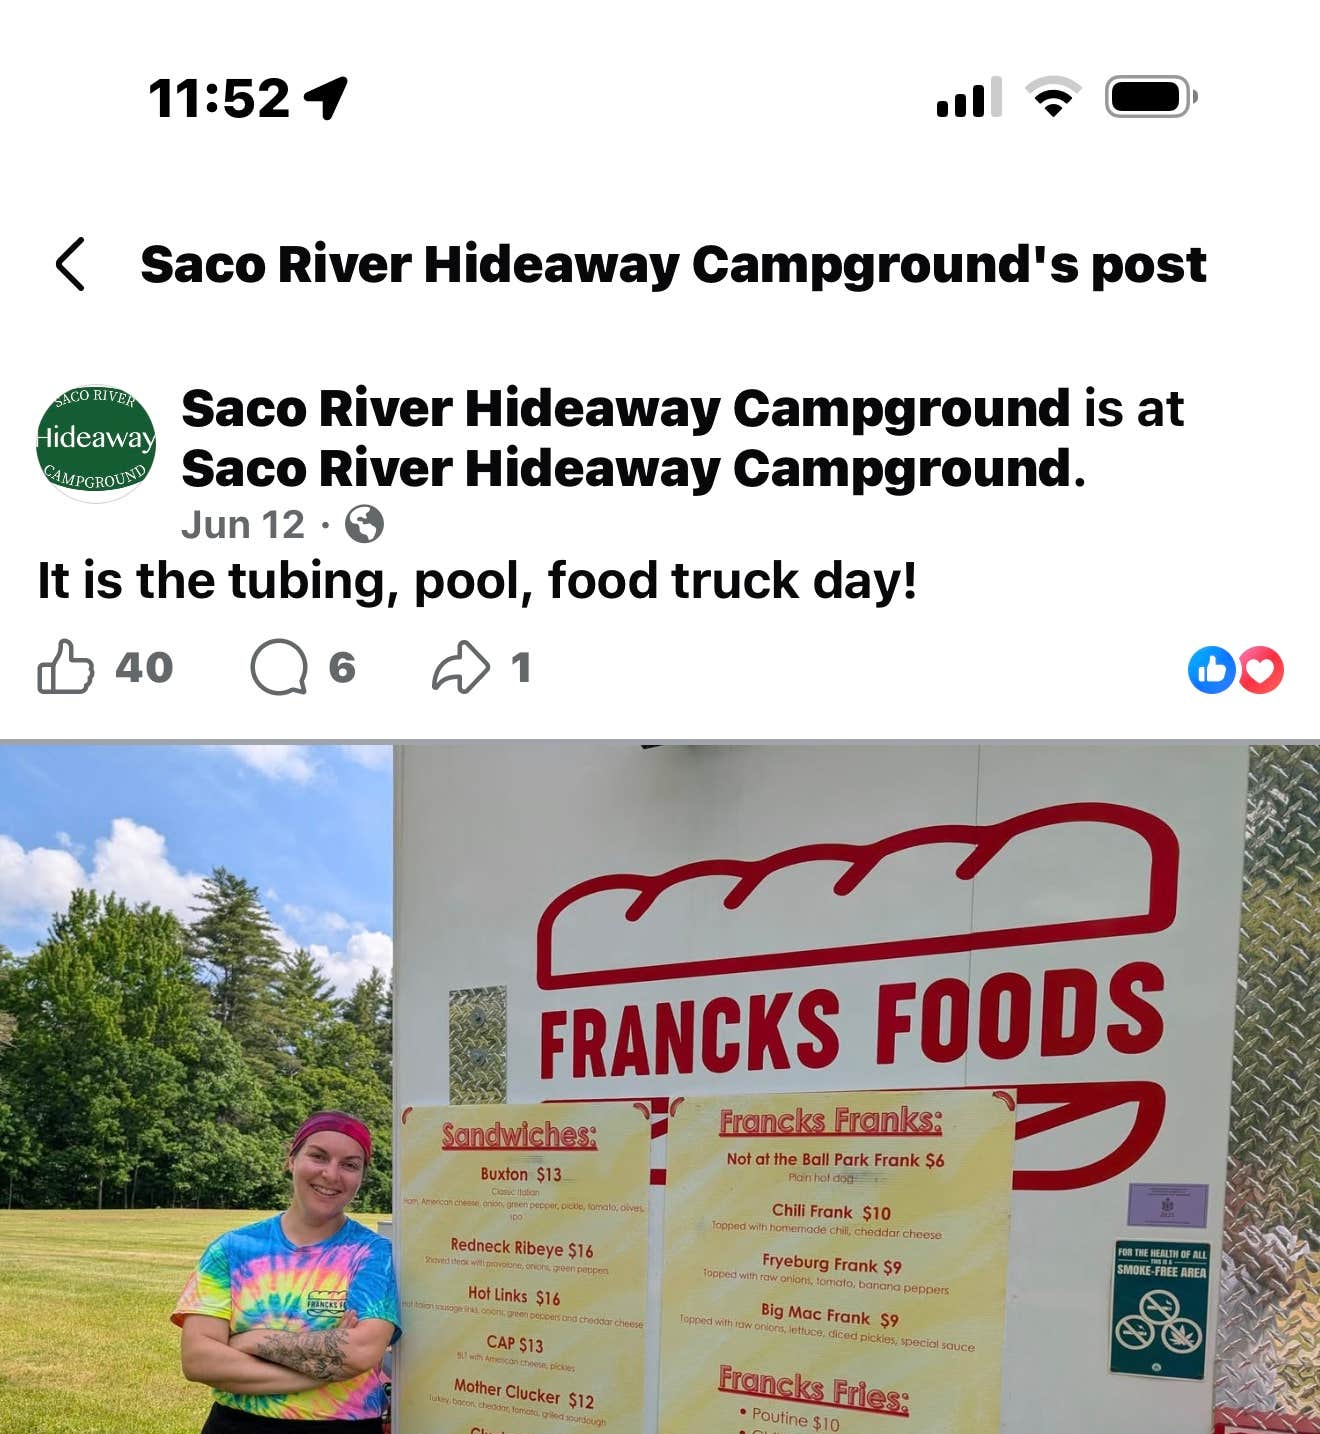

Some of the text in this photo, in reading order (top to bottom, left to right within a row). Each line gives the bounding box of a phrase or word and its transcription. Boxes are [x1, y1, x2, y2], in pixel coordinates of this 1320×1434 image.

[149, 77, 290, 119] 11:52
[141, 239, 1207, 293] Saco River Hideaway Campground's post
[55, 390, 136, 408] SACO RIVER
[182, 384, 1185, 437] Saco River Hideaway Campground is at
[36, 424, 157, 454] Hideaway
[44, 464, 146, 488] CAMPGROUND
[182, 444, 1085, 497] Saco River Hideaway Campground.
[181, 509, 305, 539] Jun 12
[39, 557, 916, 609] It is the tubing, pool, food truck day!
[115, 651, 173, 684] 40
[329, 651, 356, 684] 6
[512, 652, 529, 683] 1
[540, 961, 1165, 1080] FRANCKS FOODS
[720, 1106, 943, 1134] Francks Franks:
[442, 1121, 597, 1149] Sandwiches:
[481, 1166, 562, 1183] Buxton $13
[727, 1152, 945, 1170] Not at the Ball Park Frank $6
[517, 1188, 540, 1197] Italian
[789, 1172, 855, 1185] Plain hot dog
[772, 1203, 892, 1222] Chili Frank $10
[712, 1220, 943, 1241] Topped with homemade chili, cheddar cheese
[451, 1237, 594, 1260] Redneck Ribeye $16
[1118, 1247, 1208, 1260] FOR THE HEALTH OF ALL
[762, 1253, 903, 1277] Fryeburg Frank $9
[1117, 1264, 1207, 1279] SMOKE-FREE AREA
[703, 1267, 950, 1296] Topped with raw onions, tomato, banana peppers
[308, 1300, 338, 1309] FRANCKS
[468, 1286, 560, 1307] Hot Links $16
[761, 1302, 900, 1330] Big Mac Frank $9
[487, 1334, 544, 1354] CAP $13
[680, 1313, 976, 1353] Topped with raw onions, lettuce, diced pickles, special sauce
[454, 1378, 595, 1410] Mother Clucker $12
[719, 1364, 910, 1413] Francks Fries:
[752, 1407, 840, 1433] Poutine $10
